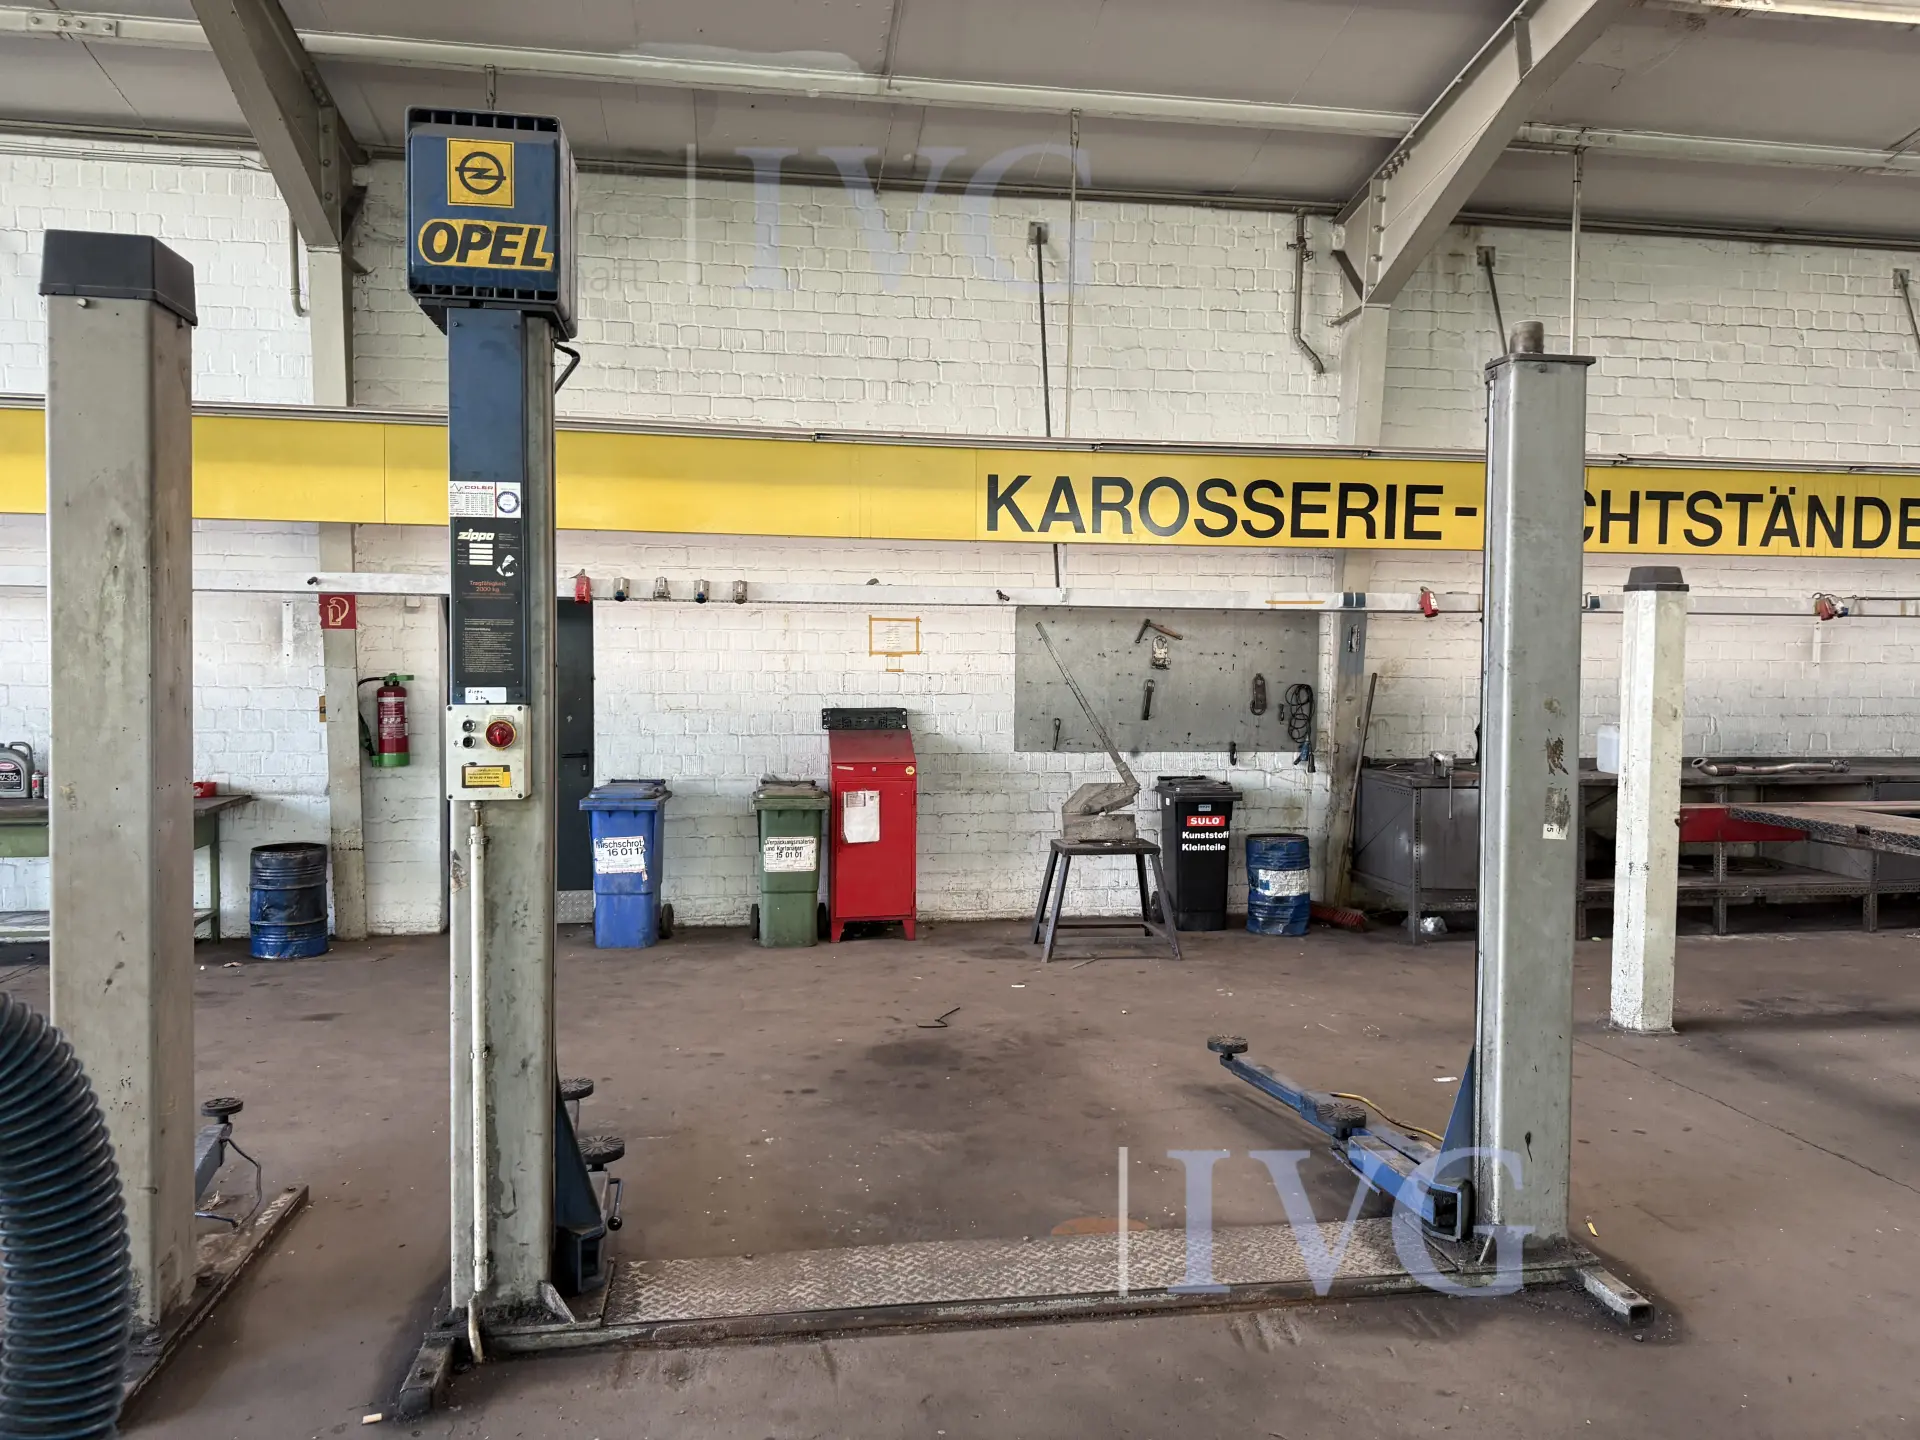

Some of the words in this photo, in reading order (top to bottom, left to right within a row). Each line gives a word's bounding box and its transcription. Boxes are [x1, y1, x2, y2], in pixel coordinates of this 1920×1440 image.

[420, 219, 550, 269] OPEL
[986, 473, 1478, 541] KAROSSERIE-
[1584, 485, 1920, 550] HTSTÄNDE
[457, 528, 495, 541] zippo
[1190, 817, 1220, 825] SULO
[1182, 830, 1229, 839] Kunststoff
[1181, 843, 1226, 851] Kleinteile
